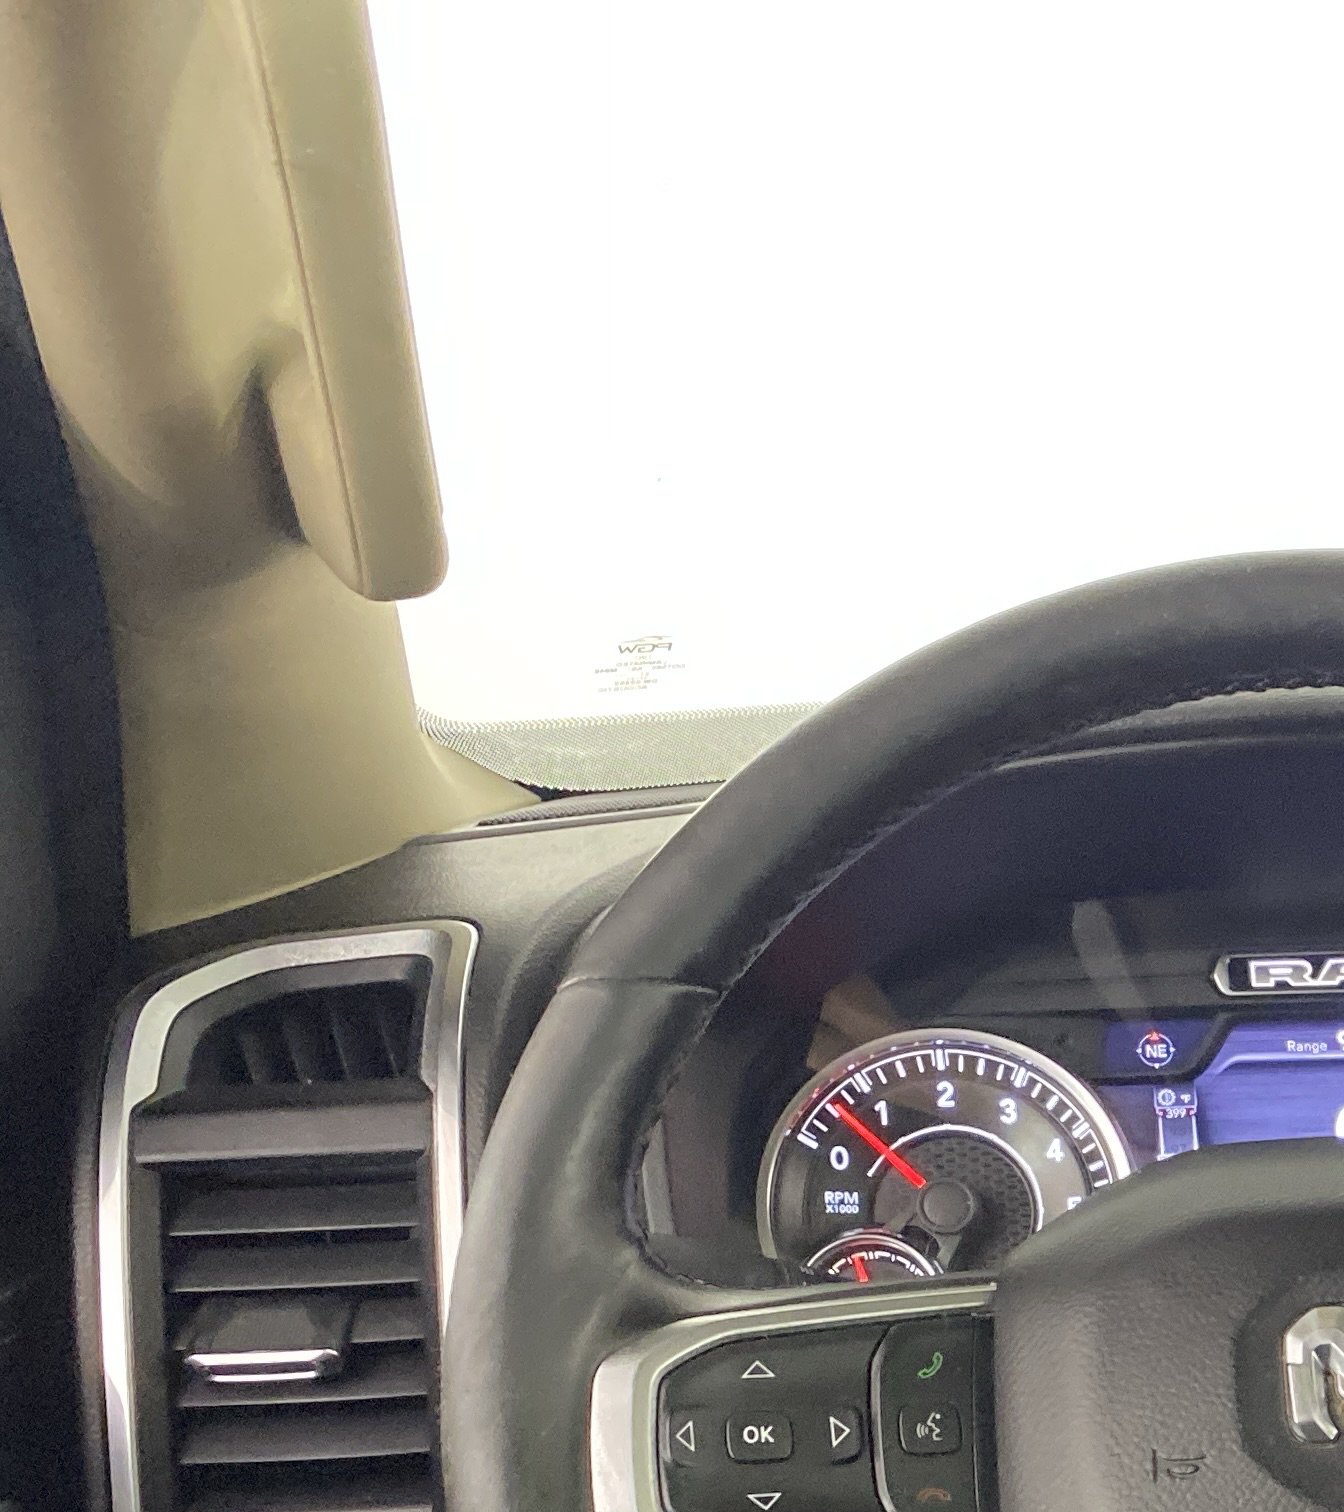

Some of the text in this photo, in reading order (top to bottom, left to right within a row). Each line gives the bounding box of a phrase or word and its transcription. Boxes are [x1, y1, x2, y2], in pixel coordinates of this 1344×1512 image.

[1145, 1044, 1167, 1058] NE
[1287, 1039, 1328, 1053] Range
[937, 1082, 955, 1108] 2
[875, 1100, 889, 1125] 1
[1000, 1099, 1018, 1123] 3
[829, 1146, 849, 1171] 0
[1046, 1138, 1064, 1162] 4
[824, 1191, 859, 1204] RPM
[825, 1203, 860, 1214] X1000
[742, 1425, 774, 1444] OK
